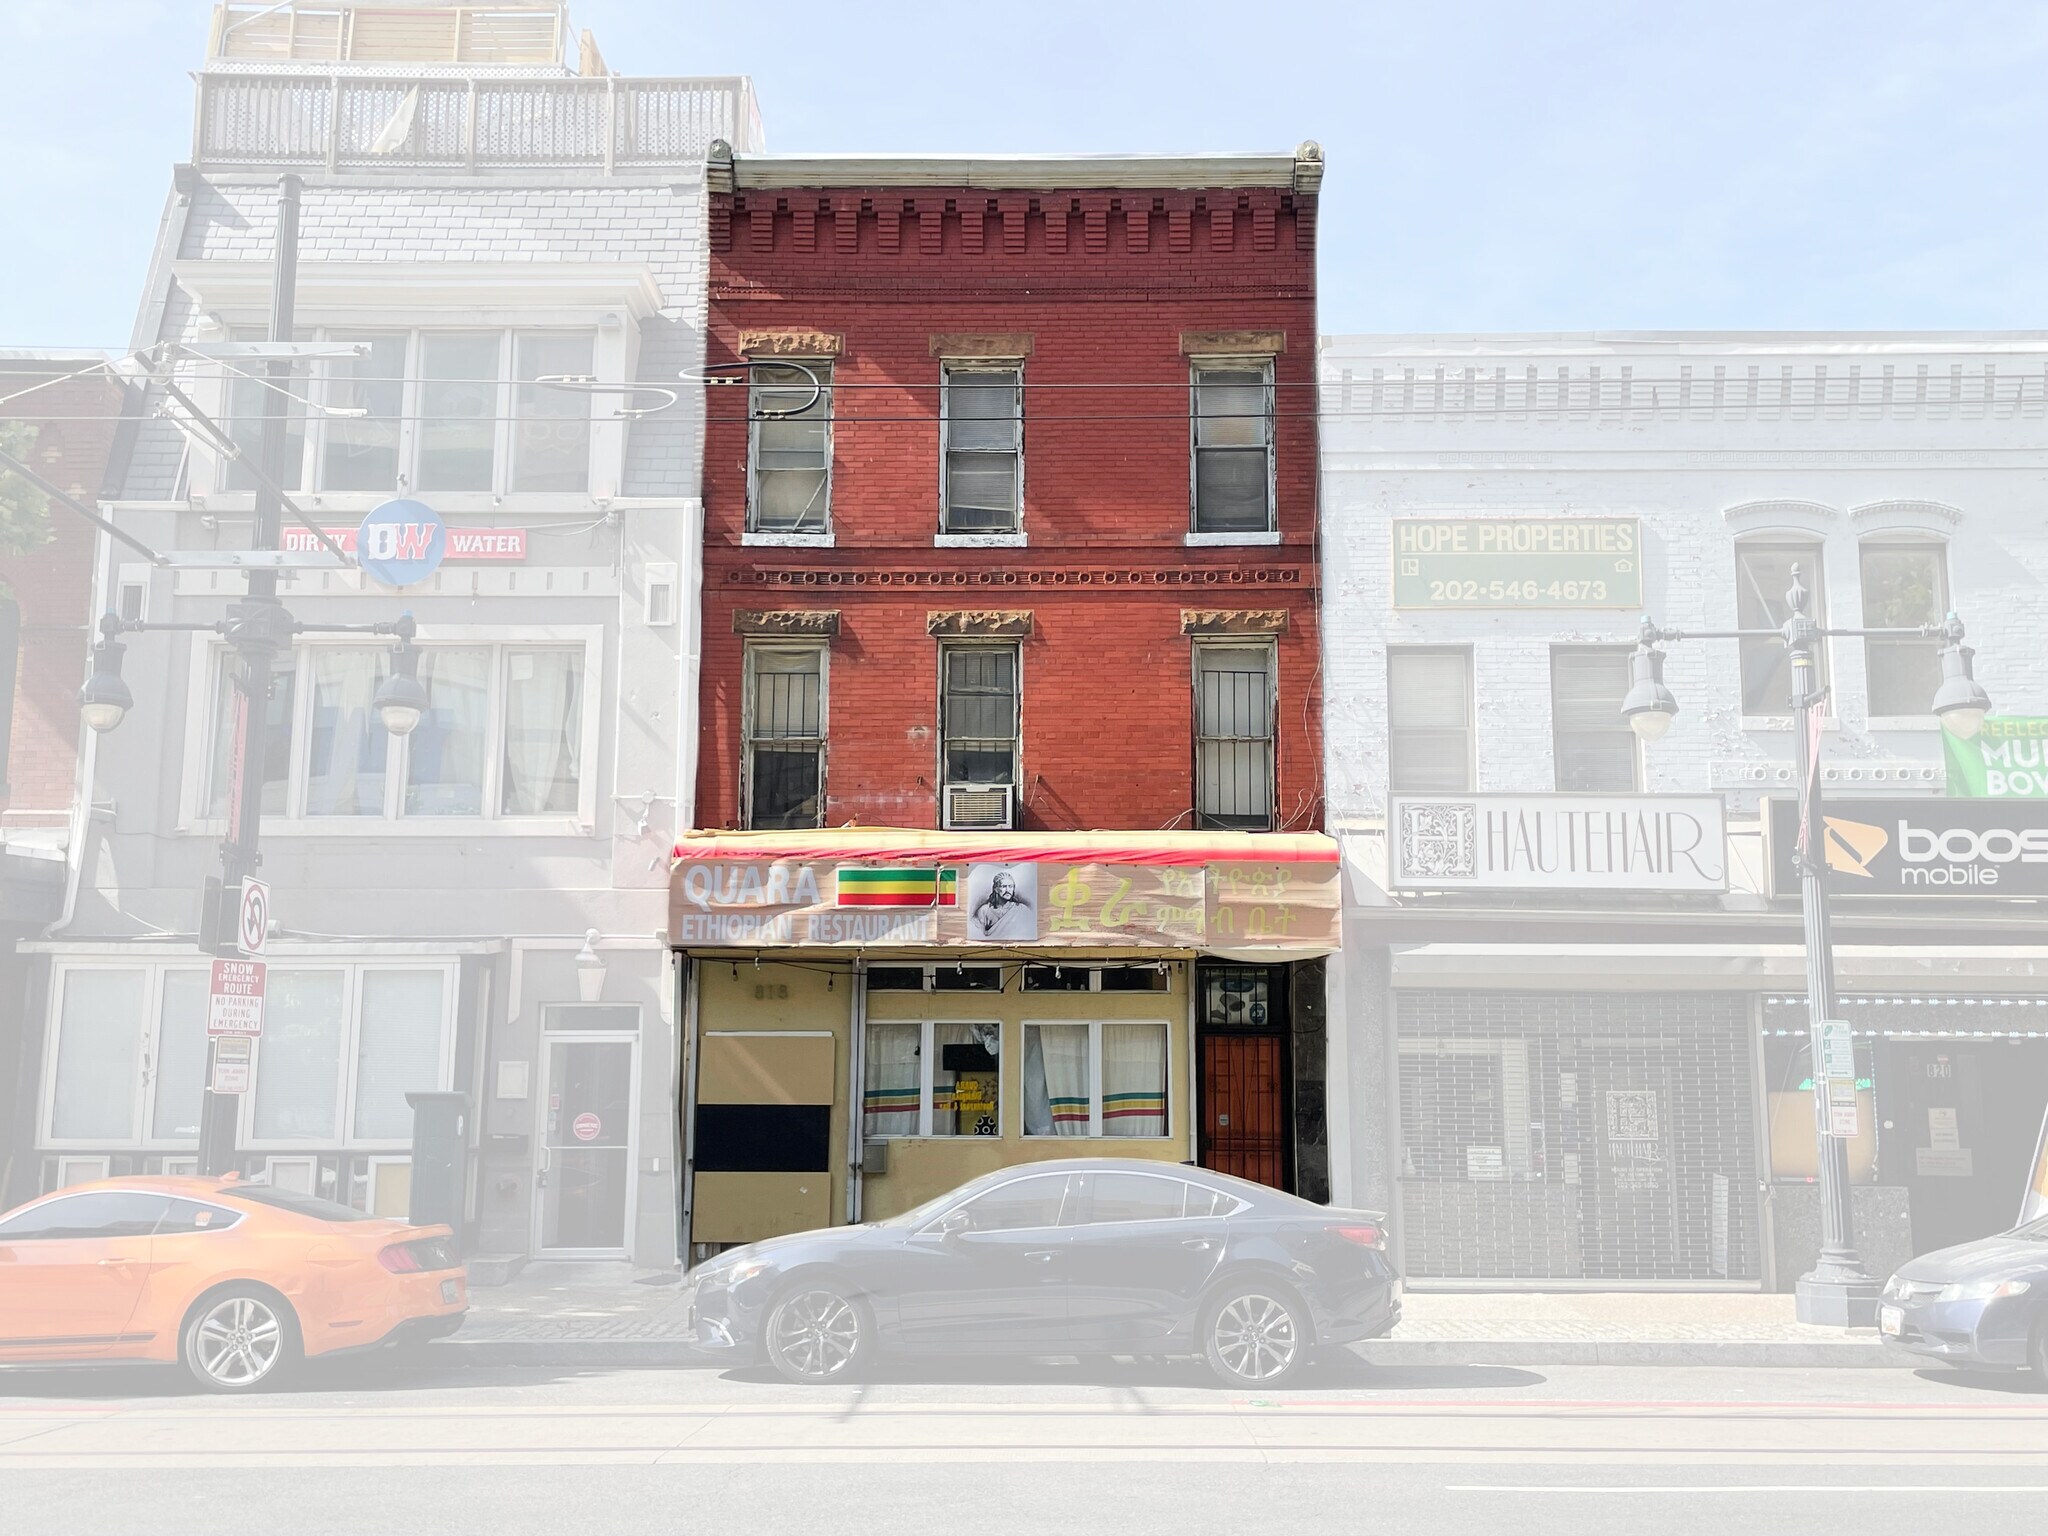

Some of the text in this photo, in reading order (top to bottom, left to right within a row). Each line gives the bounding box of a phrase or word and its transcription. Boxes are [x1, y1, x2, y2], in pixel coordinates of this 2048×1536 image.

[367, 523, 438, 560] DW
[452, 534, 521, 553] WATER
[1401, 523, 1633, 552] HOPE PROPERTIES
[1980, 739, 2048, 768] MU
[1486, 807, 1723, 882] HAUTEHAIR
[1901, 864, 1998, 885] mobile
[684, 864, 821, 912] QUARA
[682, 914, 930, 941] ETHIOPIAN RESTAURANT
[218, 973, 259, 984] EMERGENCY
[223, 963, 254, 975] SNOW
[223, 983, 252, 995] ROUTE
[216, 996, 259, 1008] NO PARKING
[222, 1007, 250, 1018] DURING
[213, 1018, 258, 1029] EMERGENCY
[1927, 1063, 1951, 1078] 820
